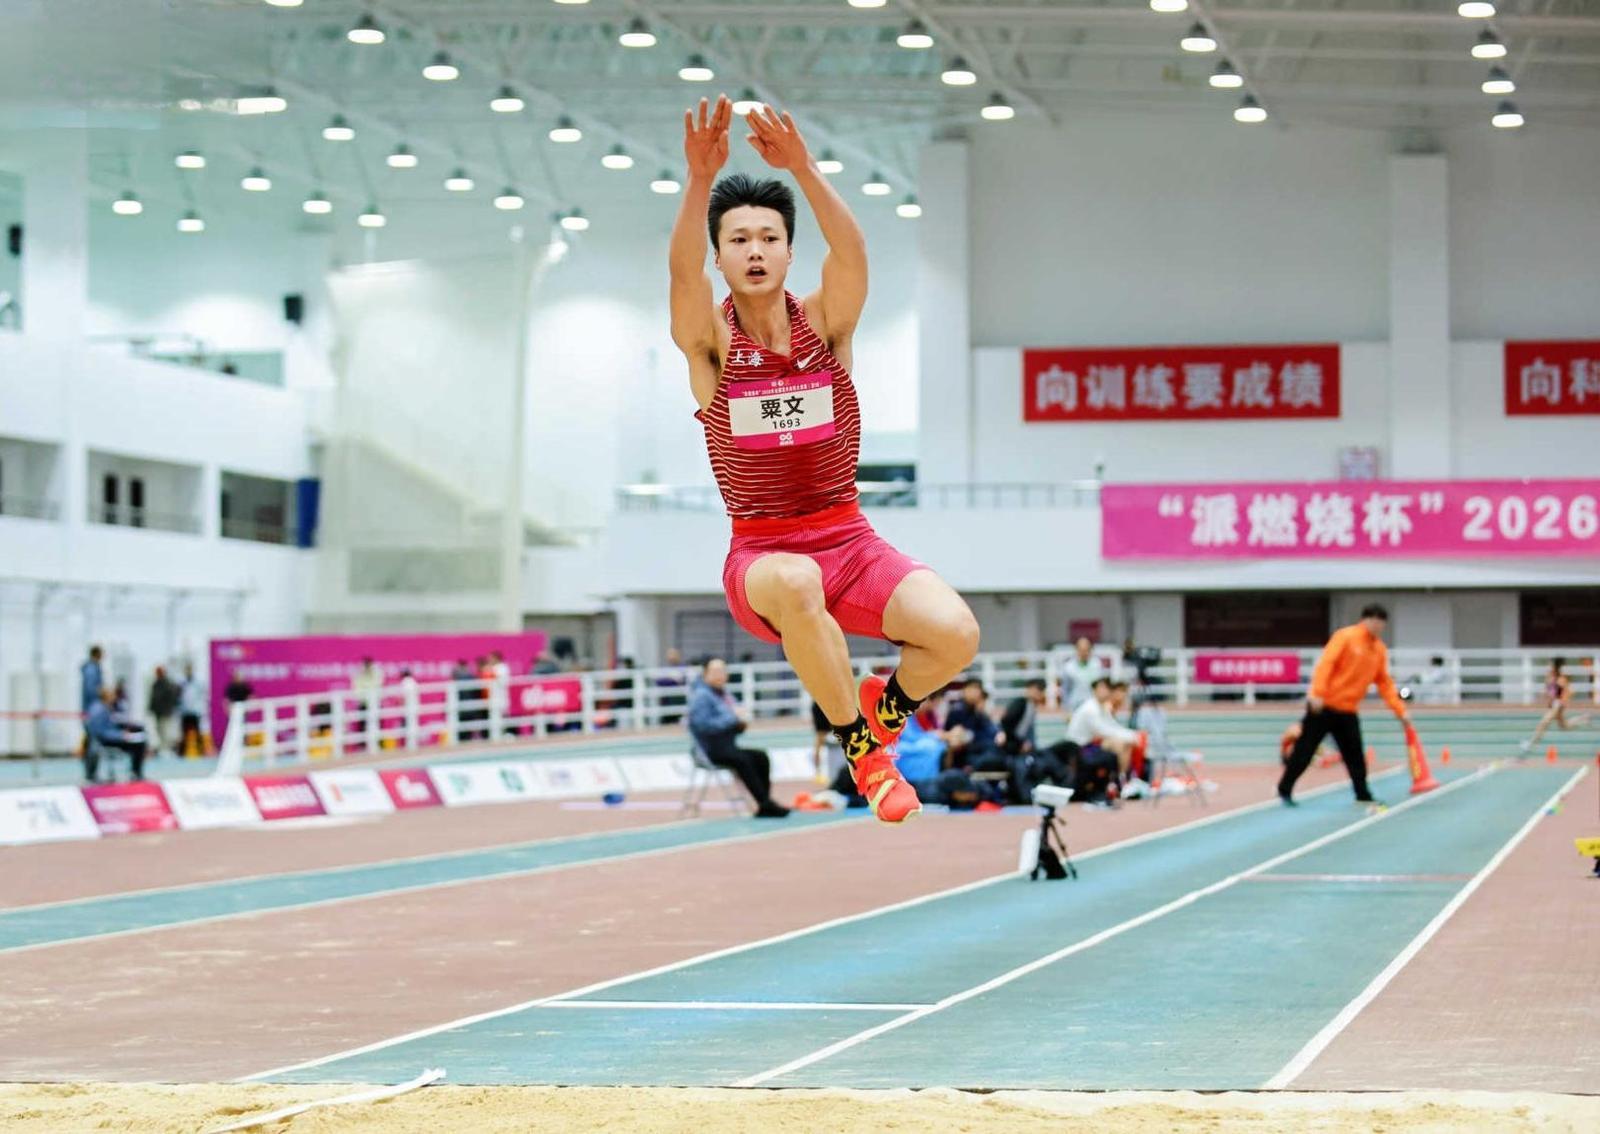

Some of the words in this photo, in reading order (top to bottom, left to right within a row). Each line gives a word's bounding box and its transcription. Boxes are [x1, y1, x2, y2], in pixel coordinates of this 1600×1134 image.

[731, 349, 764, 367] 上海
[1036, 360, 1323, 412] 向训练要成绩
[760, 396, 804, 419] 粟文
[772, 418, 801, 430] 1693
